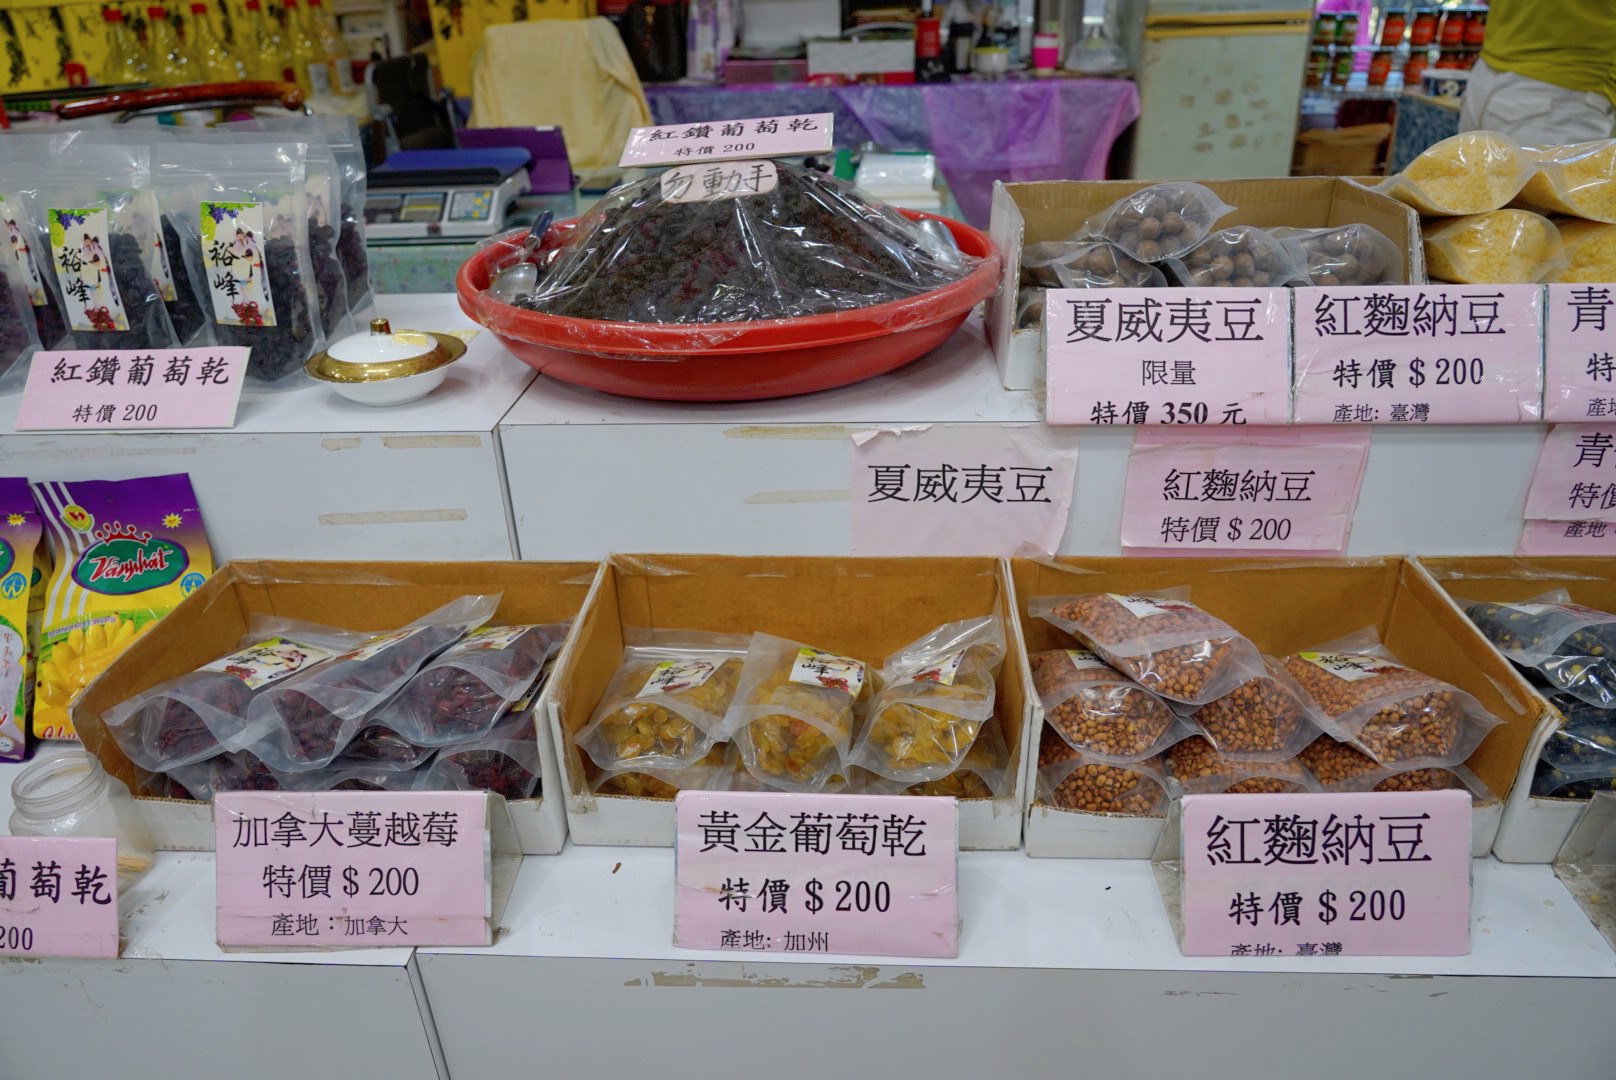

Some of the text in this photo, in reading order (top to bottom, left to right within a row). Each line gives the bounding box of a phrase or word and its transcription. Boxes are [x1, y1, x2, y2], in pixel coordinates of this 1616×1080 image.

[649, 118, 818, 142] 紅鑽葡萄乾
[674, 142, 755, 157] 特價 200
[664, 164, 773, 200] 勿動手
[1066, 297, 1264, 344] 夏威夷豆
[1315, 292, 1506, 338] 紅麴納豆
[1567, 286, 1614, 332] 青
[50, 355, 231, 387] 紅鑽葡萄乾
[1141, 359, 1197, 386] 限量
[1332, 358, 1397, 389] 特價
[1586, 352, 1616, 383] 特
[72, 404, 158, 424] 特價 200
[1090, 400, 1248, 425] 特價 350 元
[1573, 432, 1616, 468] 青
[867, 463, 1053, 504] 夏威夷豆
[1162, 468, 1316, 503] 紅麴納豆
[1160, 516, 1220, 543] 特價
[232, 811, 459, 848] 加拿大蔓越莓
[697, 810, 927, 857] 黃金葡萄乾
[1206, 813, 1432, 866] 紅麴納豆
[262, 864, 331, 899] 特價
[718, 877, 791, 914] 特價
[1228, 891, 1303, 926] 特價
